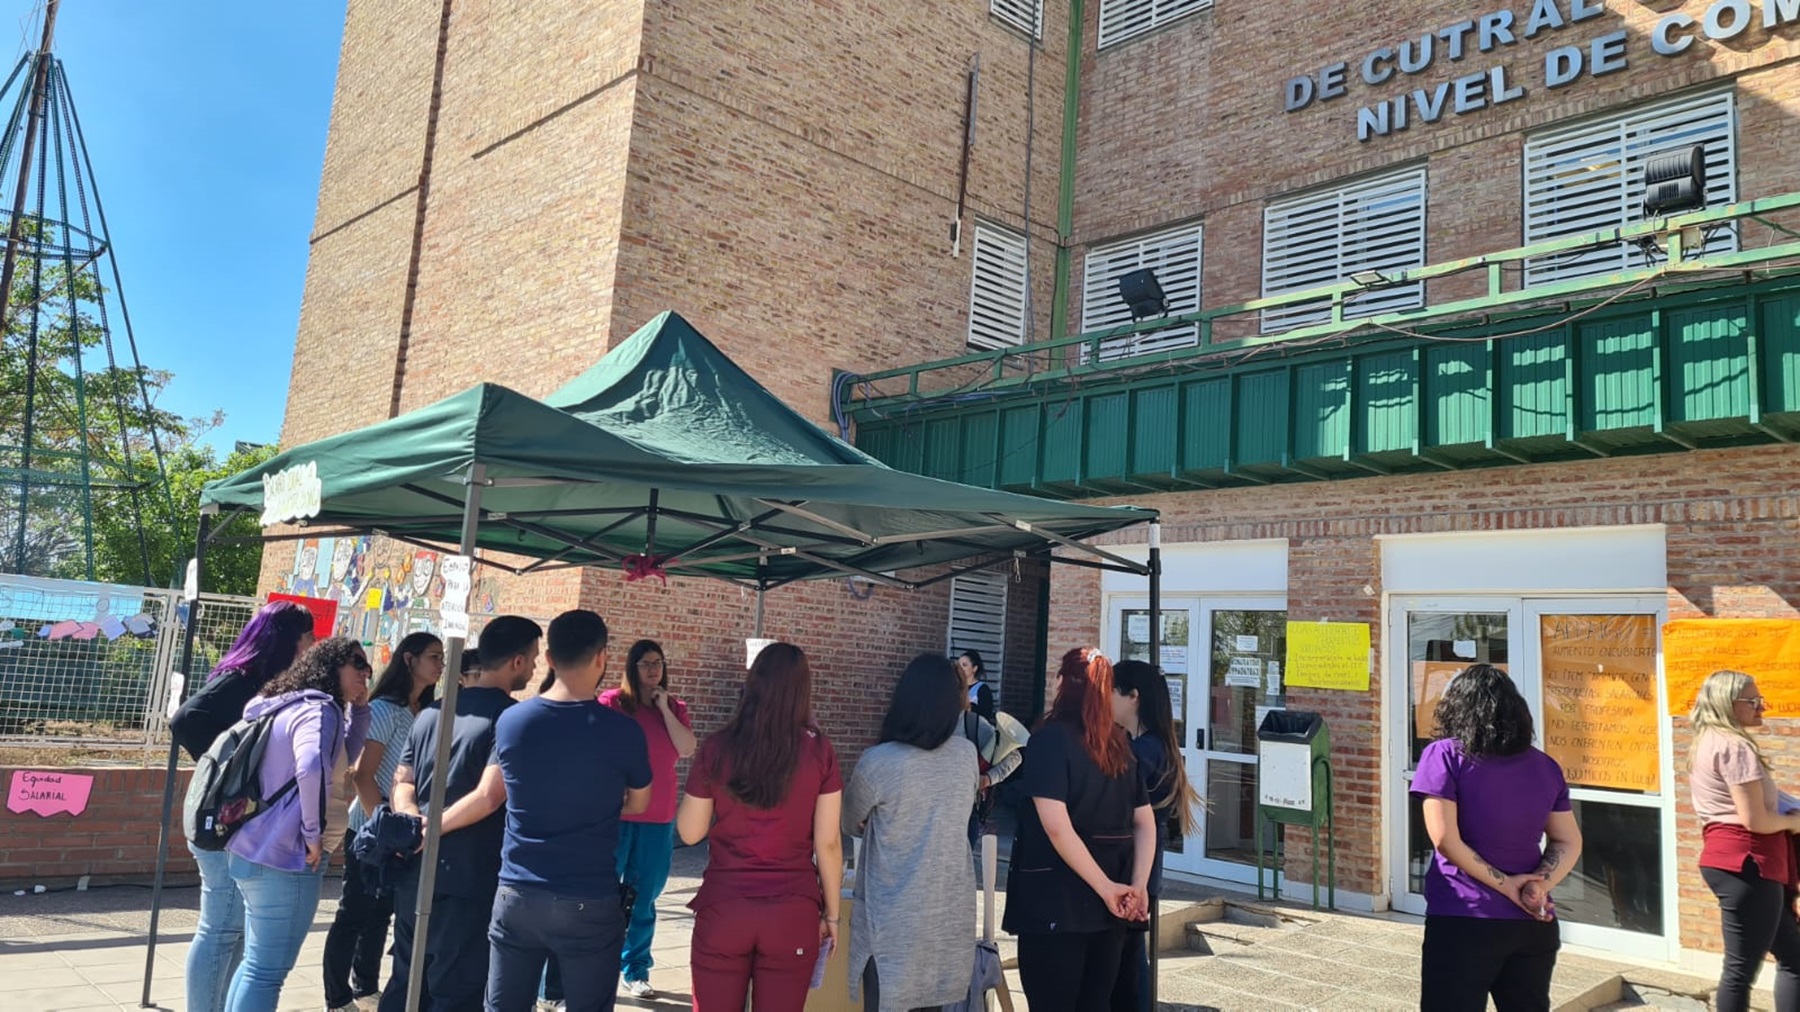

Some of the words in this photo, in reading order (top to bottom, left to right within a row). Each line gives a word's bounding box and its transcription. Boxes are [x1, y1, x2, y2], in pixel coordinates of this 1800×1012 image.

[1284, 61, 1348, 112] DE
[1356, 65, 1525, 142] NIVEL
[1545, 29, 1628, 89] DE
[1551, 719, 1565, 730] NO
[1571, 720, 1630, 735] PERMITAMOS
[1549, 735, 1567, 747] NOS
[22, 771, 62, 788] Equidad
[18, 787, 68, 801] SALARIAL
